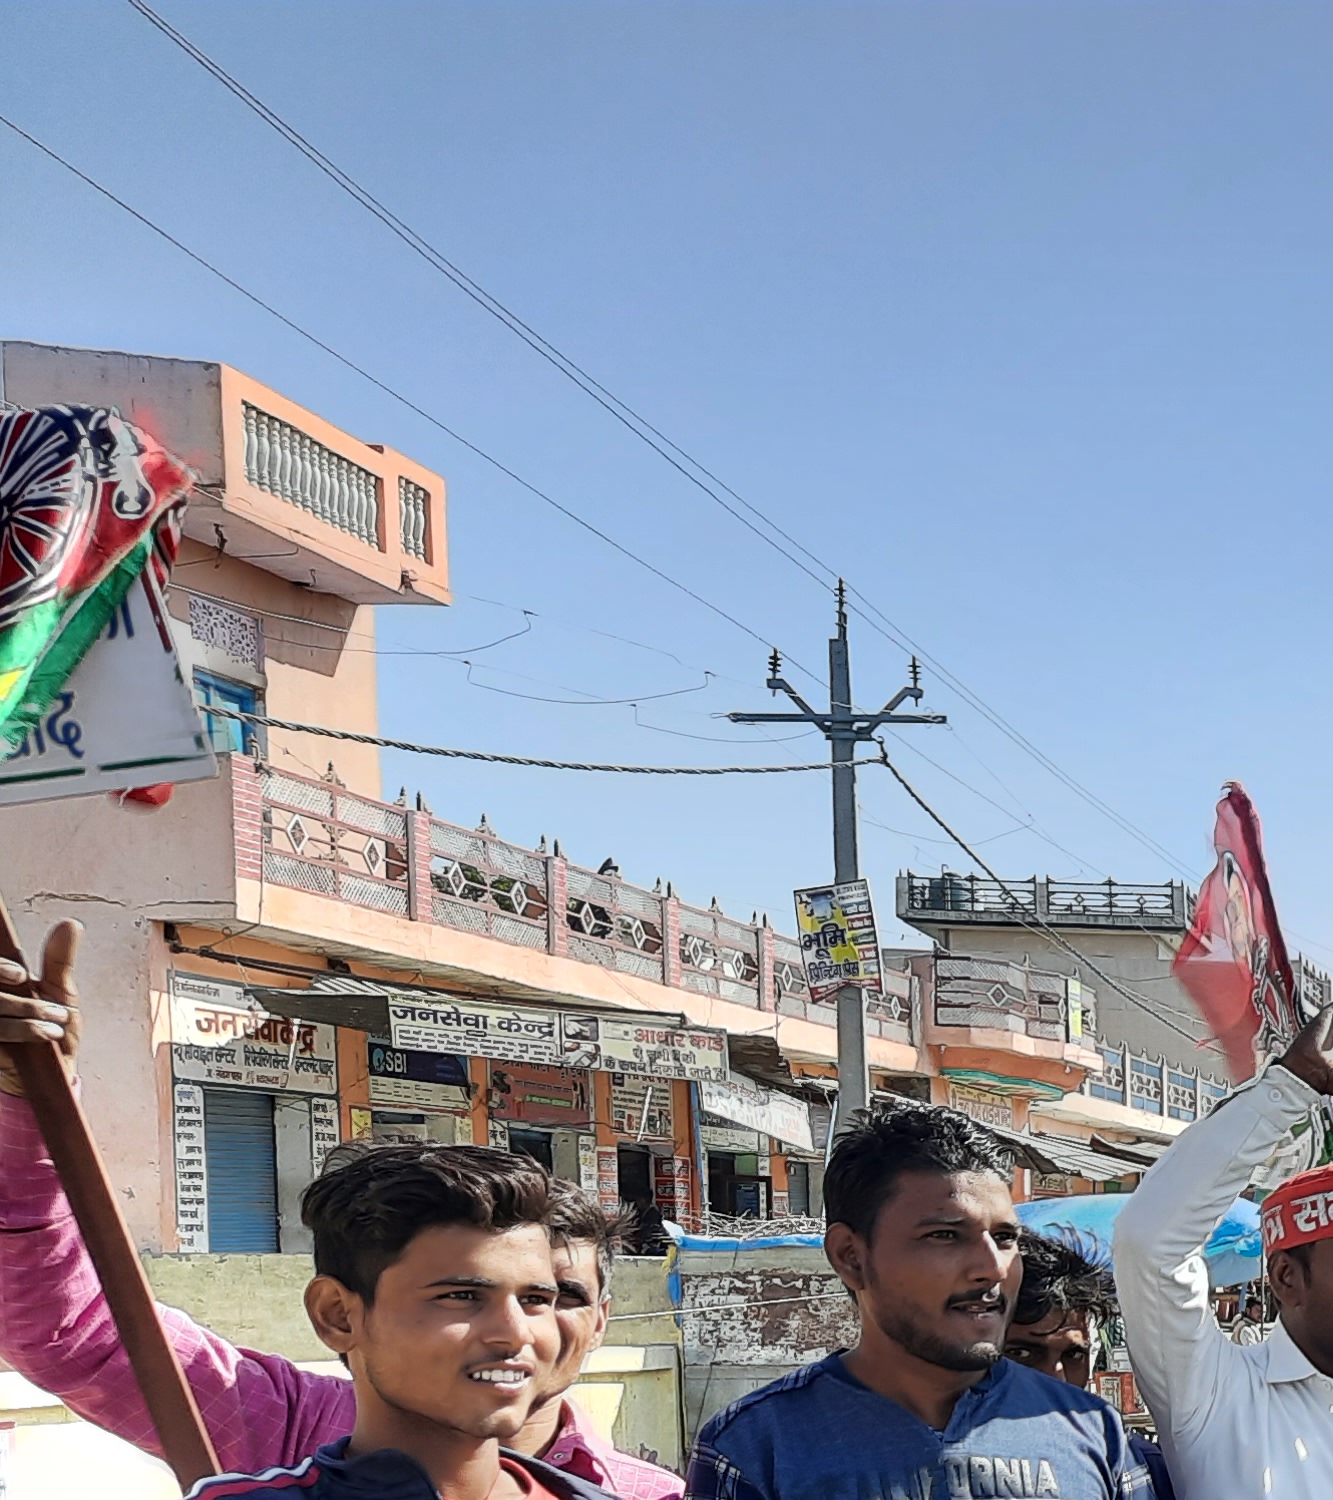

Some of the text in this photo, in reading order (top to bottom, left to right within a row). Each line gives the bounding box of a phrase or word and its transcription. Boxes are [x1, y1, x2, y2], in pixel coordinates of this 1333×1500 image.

[392, 1005, 556, 1040] जनसेवा केन्द्र
[634, 1028, 686, 1048] आधार
[385, 1051, 407, 1074] SBI
